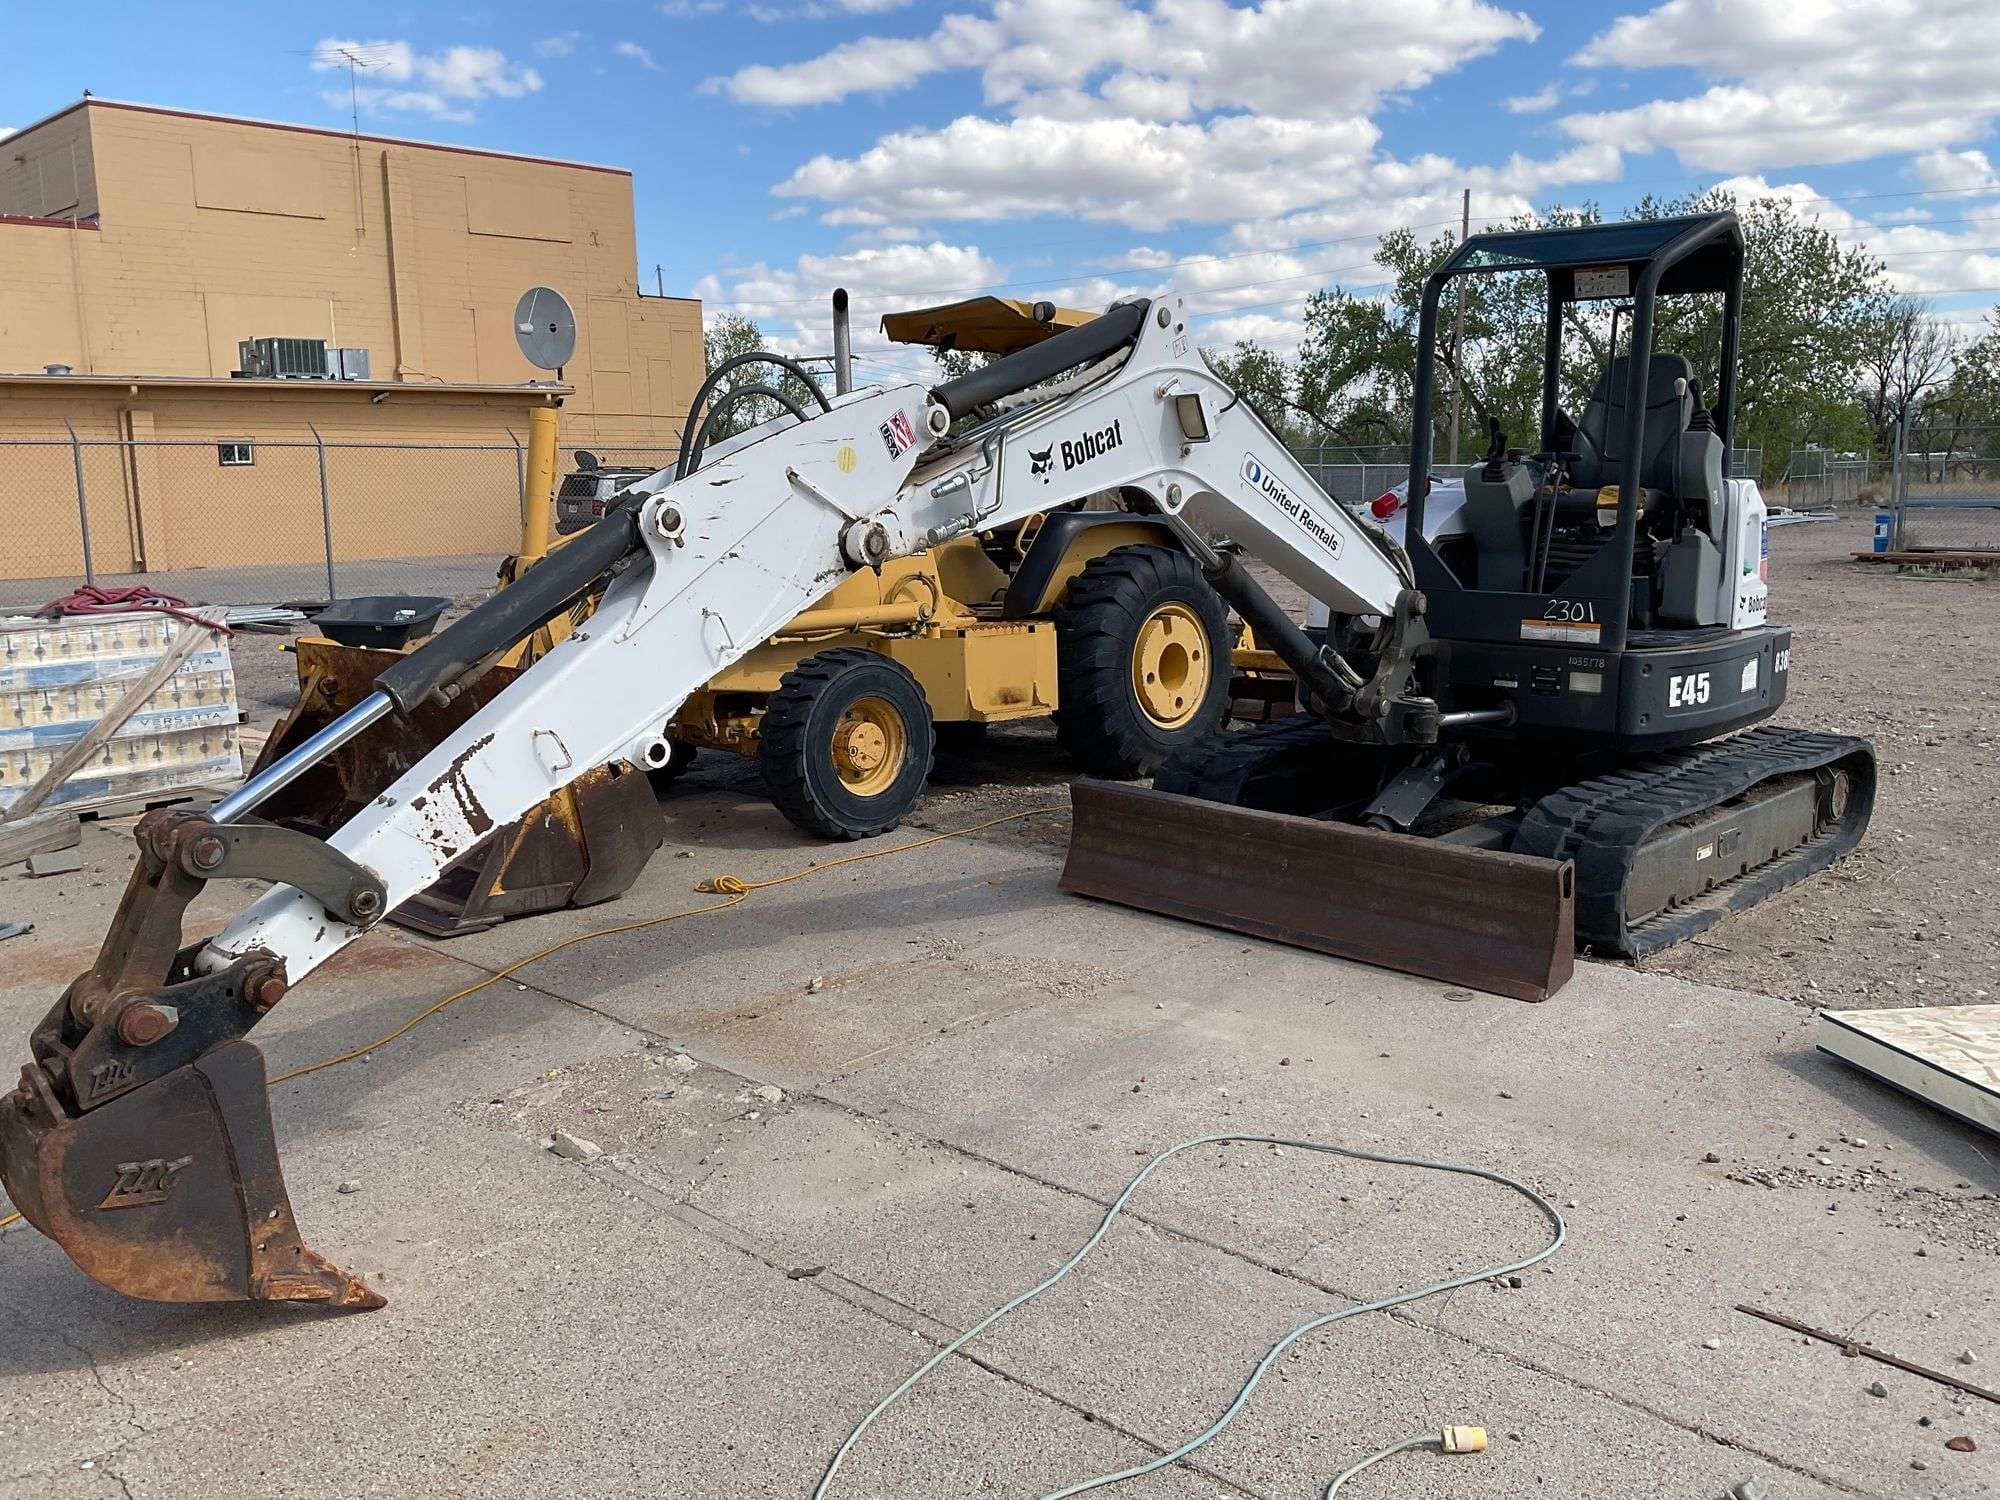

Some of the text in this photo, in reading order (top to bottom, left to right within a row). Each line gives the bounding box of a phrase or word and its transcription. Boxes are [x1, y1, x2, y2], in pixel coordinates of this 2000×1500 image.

[881, 425, 898, 458] USA
[1060, 418, 1123, 471] Bobcat
[1261, 474, 1338, 552] United Rentals
[1543, 599, 1594, 622] 2301
[1669, 671, 1710, 708] E45
